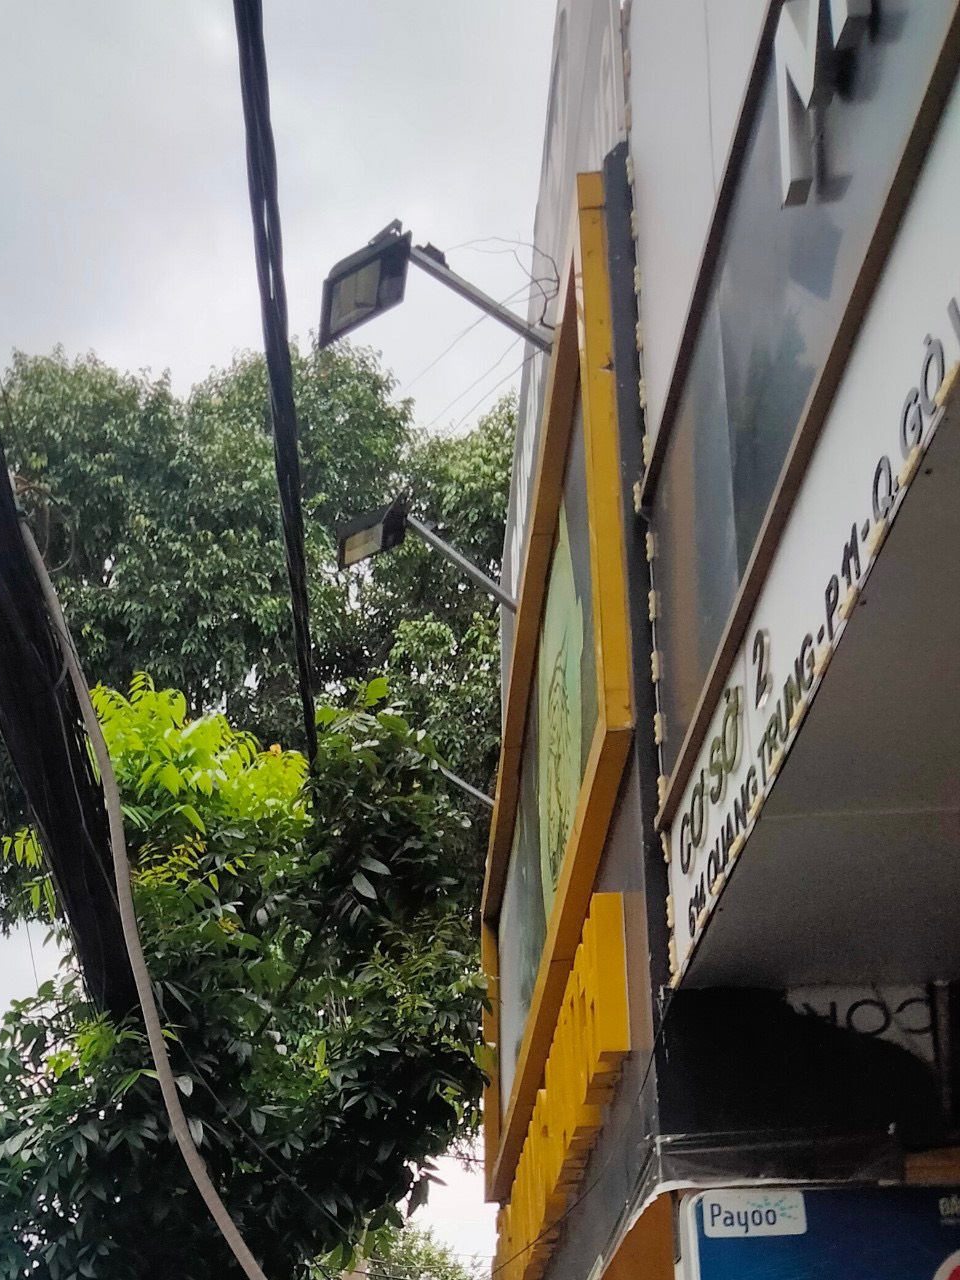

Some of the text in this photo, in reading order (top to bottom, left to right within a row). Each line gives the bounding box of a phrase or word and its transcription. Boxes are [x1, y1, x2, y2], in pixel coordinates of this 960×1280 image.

[753, 629, 771, 710] 2
[707, 765, 759, 894] QUANG
[710, 1203, 777, 1234] Payoo
